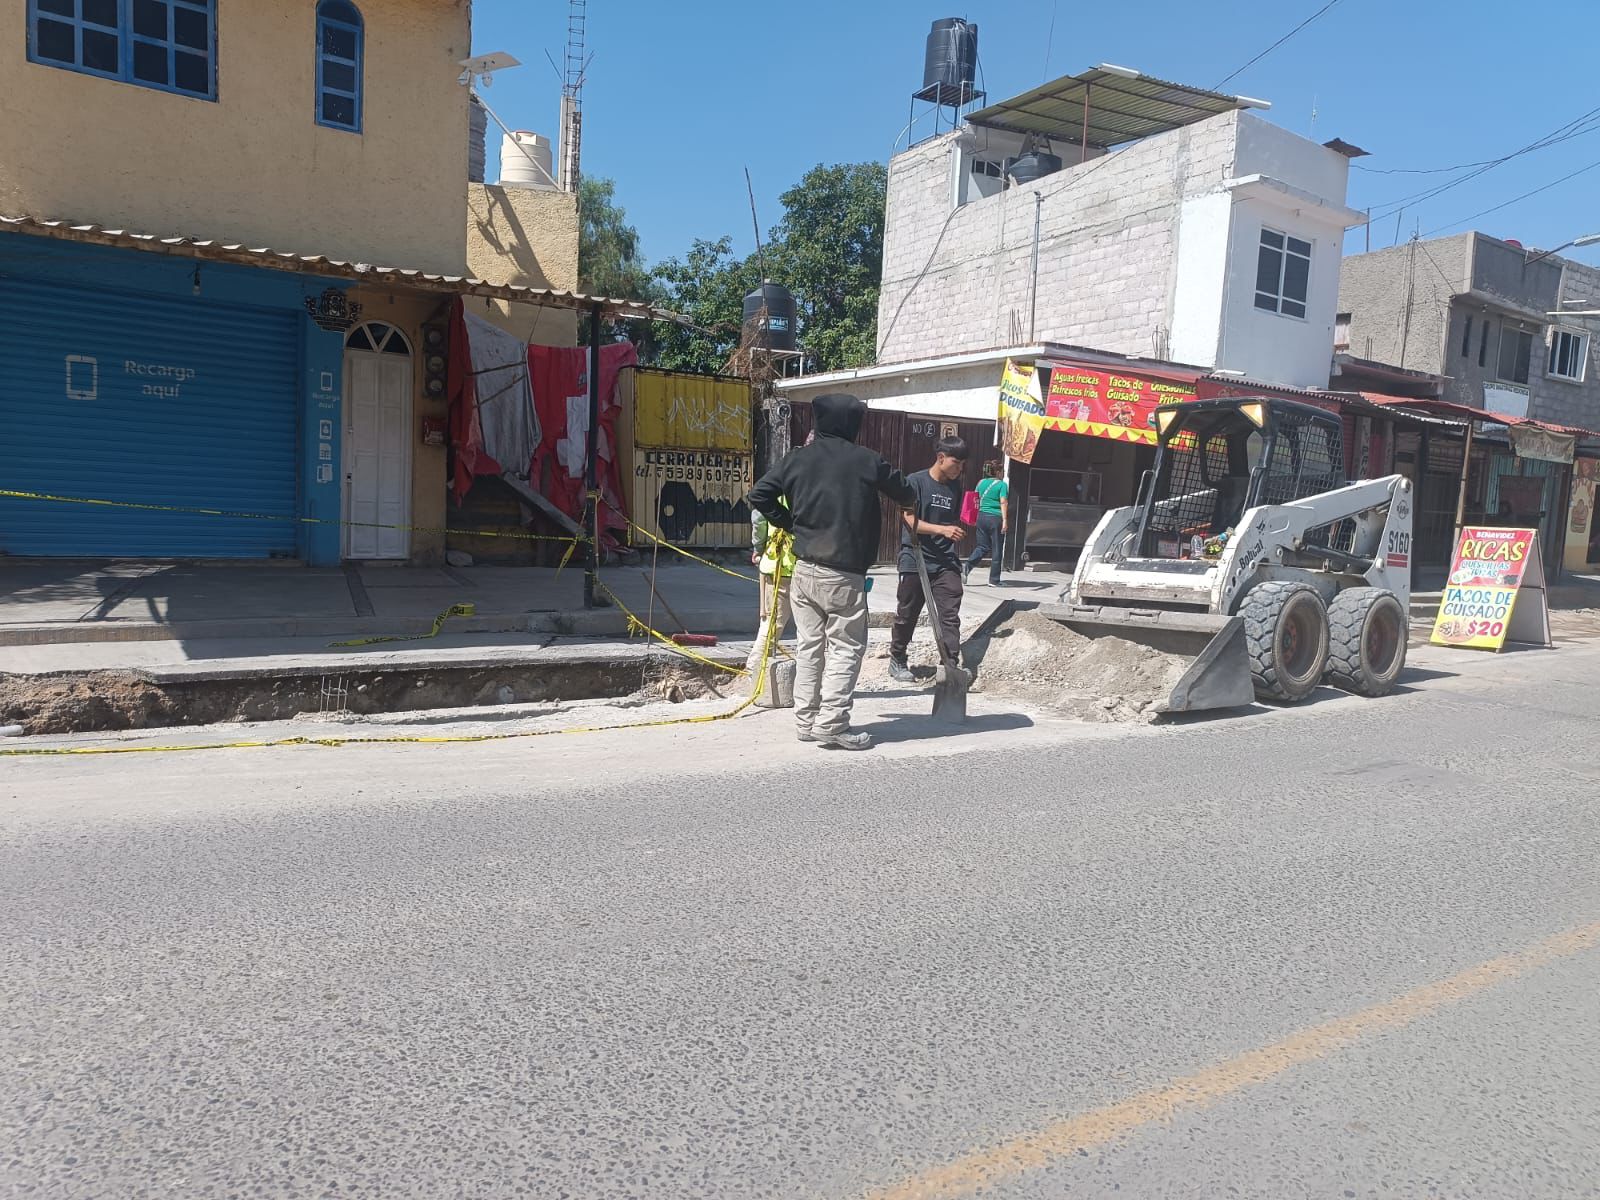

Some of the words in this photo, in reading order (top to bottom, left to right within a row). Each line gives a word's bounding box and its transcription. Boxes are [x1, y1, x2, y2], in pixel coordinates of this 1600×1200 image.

[125, 360, 195, 381] Recarga
[1054, 372, 1074, 384] Aguas
[1076, 374, 1100, 386] frescas
[142, 382, 181, 400] aquí
[1052, 384, 1082, 397] Refrescos
[1109, 375, 1131, 390] Tacos
[1132, 378, 1144, 391] de
[1106, 388, 1141, 403] Guisado
[1387, 530, 1410, 554] S160
[1461, 538, 1526, 561] RICAS
[1238, 538, 1264, 570] Bobcat
[1447, 588, 1491, 604] TACOS
[1495, 591, 1514, 606] DE
[1442, 602, 1507, 620] GUISADO
[1468, 619, 1503, 637] $20
